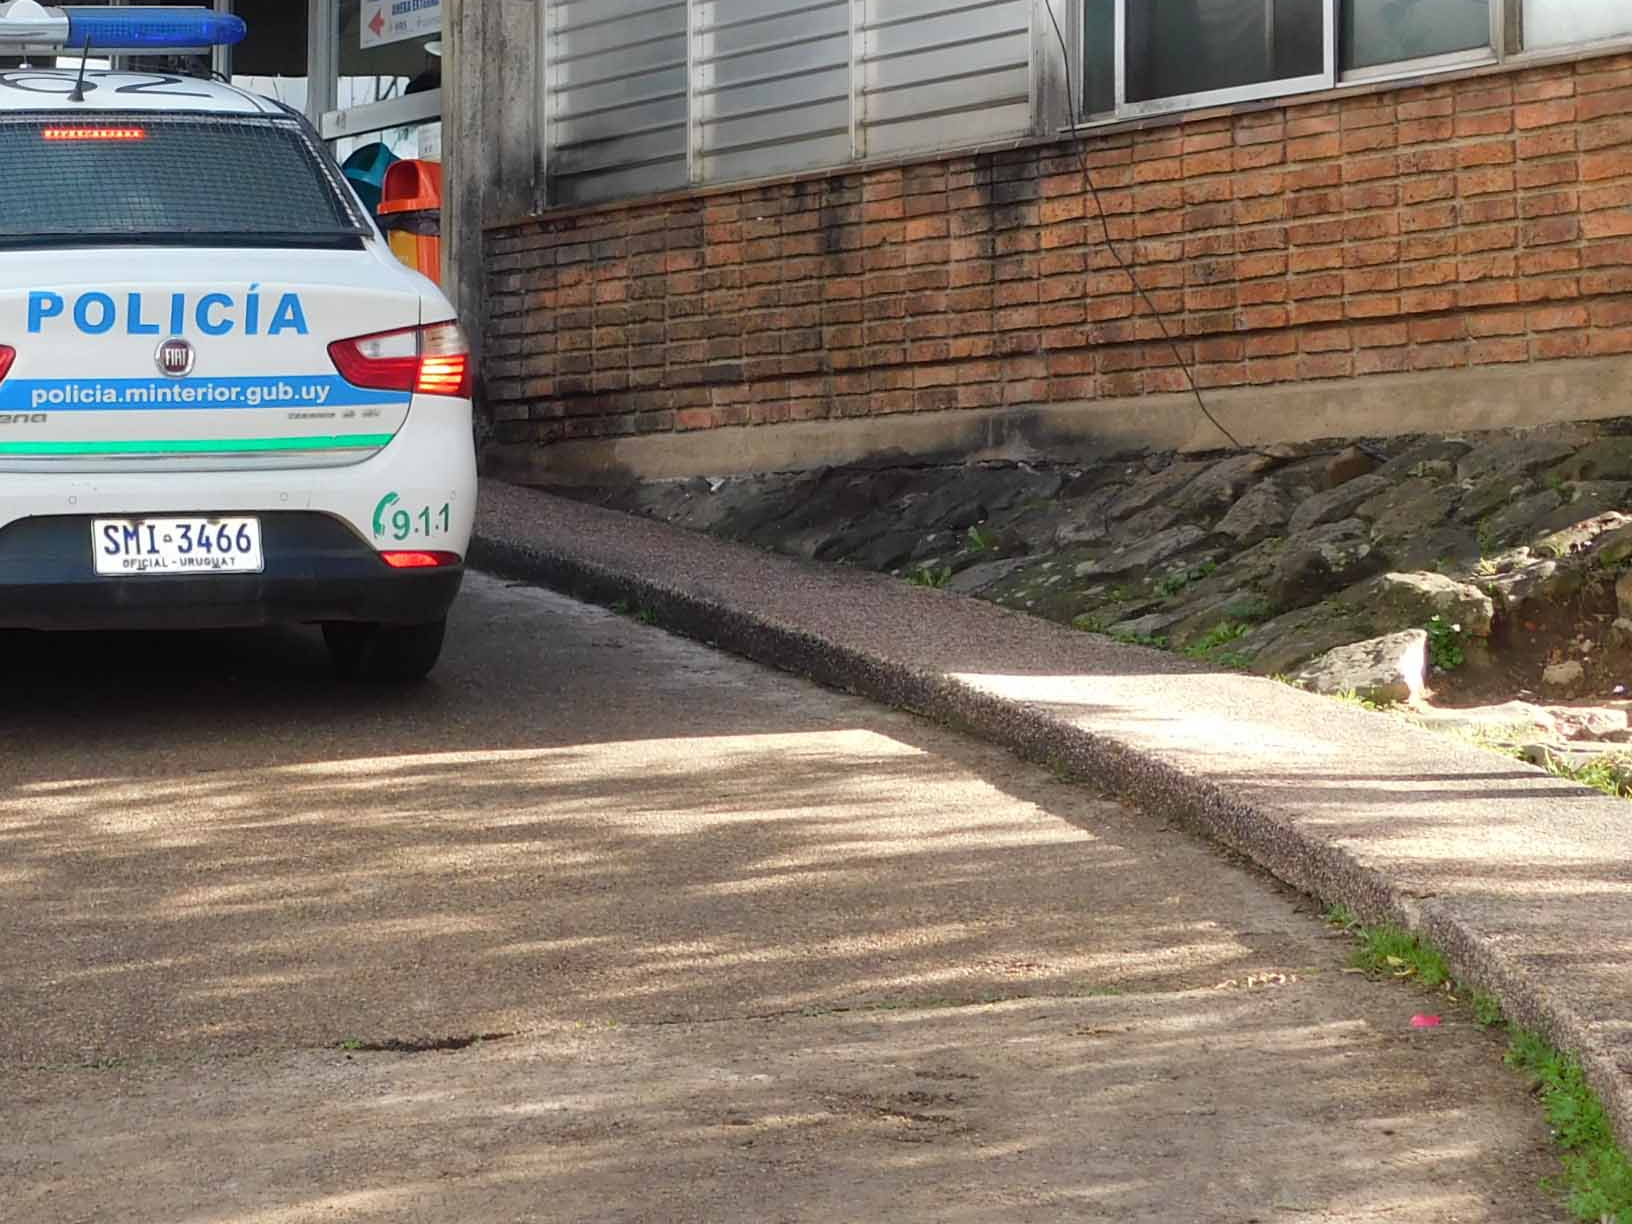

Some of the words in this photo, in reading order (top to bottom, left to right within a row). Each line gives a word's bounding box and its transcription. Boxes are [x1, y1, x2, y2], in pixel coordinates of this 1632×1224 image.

[27, 283, 308, 335] POLICÍA
[165, 348, 187, 366] FIAT
[31, 382, 330, 408] policia.minterior.gub.uy
[103, 524, 160, 555] SMI
[176, 523, 252, 554] 3466
